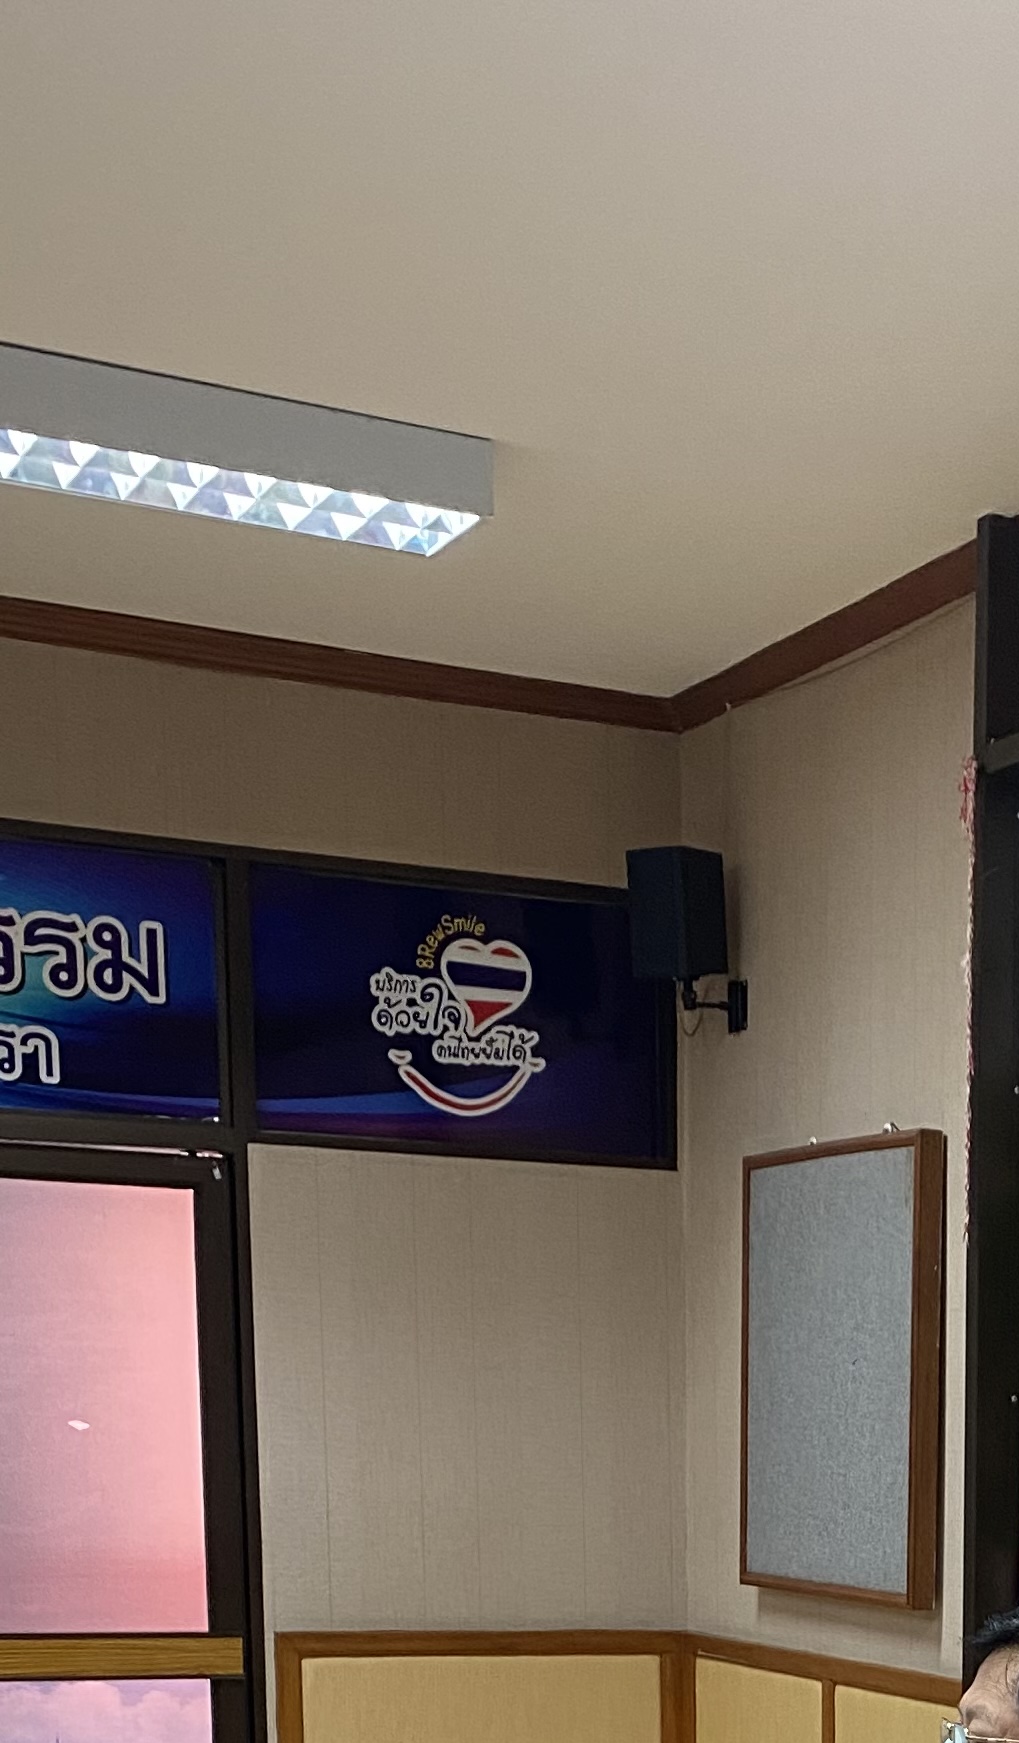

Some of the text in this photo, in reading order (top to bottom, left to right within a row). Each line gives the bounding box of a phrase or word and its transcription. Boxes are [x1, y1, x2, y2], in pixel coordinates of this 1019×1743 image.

[375, 971, 417, 994] บริการ
[377, 983, 461, 1031] ด้วยใจ
